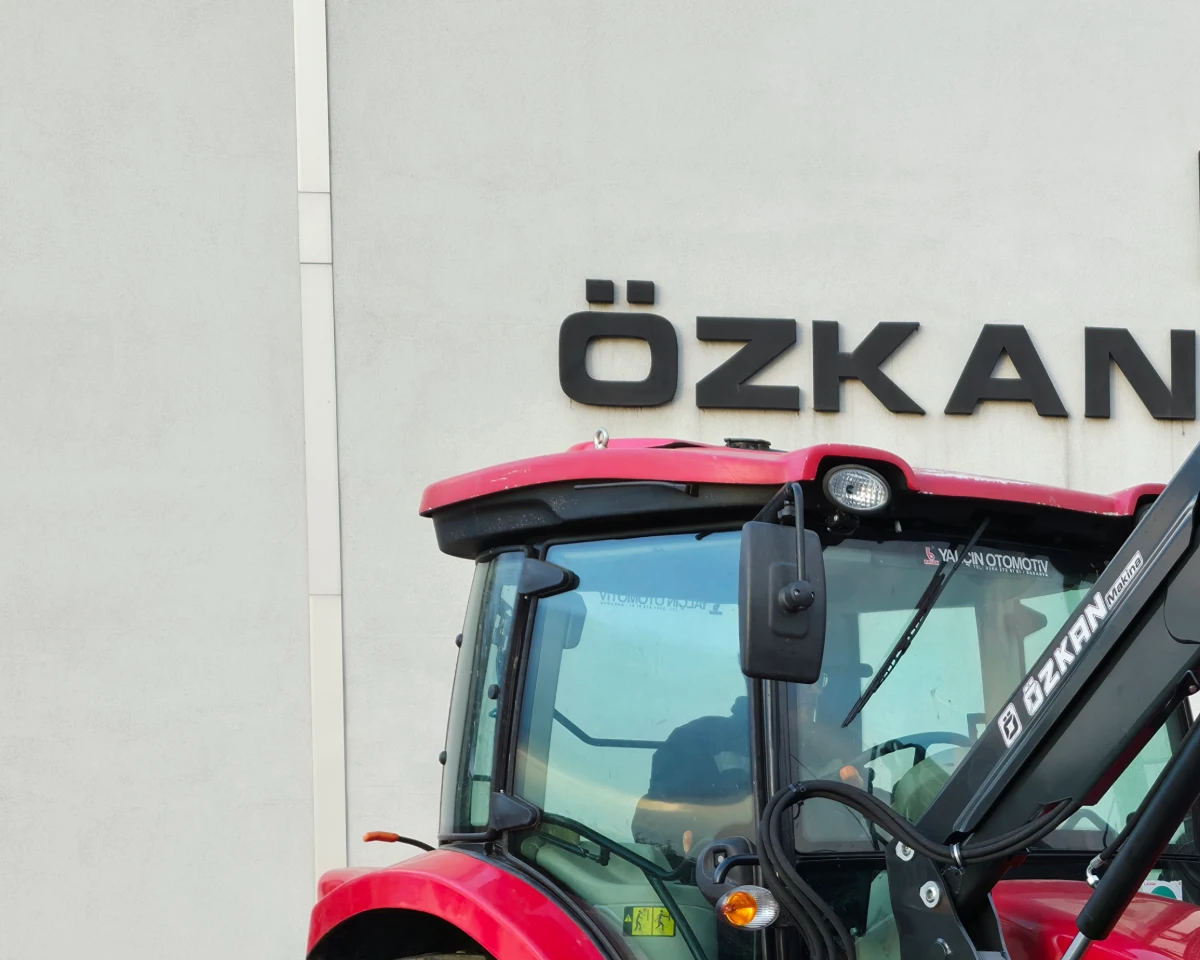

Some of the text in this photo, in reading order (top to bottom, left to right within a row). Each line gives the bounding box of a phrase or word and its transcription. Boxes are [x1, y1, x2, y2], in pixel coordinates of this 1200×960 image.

[558, 279, 1197, 421] ÖZKAN
[985, 553, 1049, 573] OTOMOTİV
[1022, 591, 1108, 716] ÖZKAN
[1106, 555, 1142, 607] Makina
